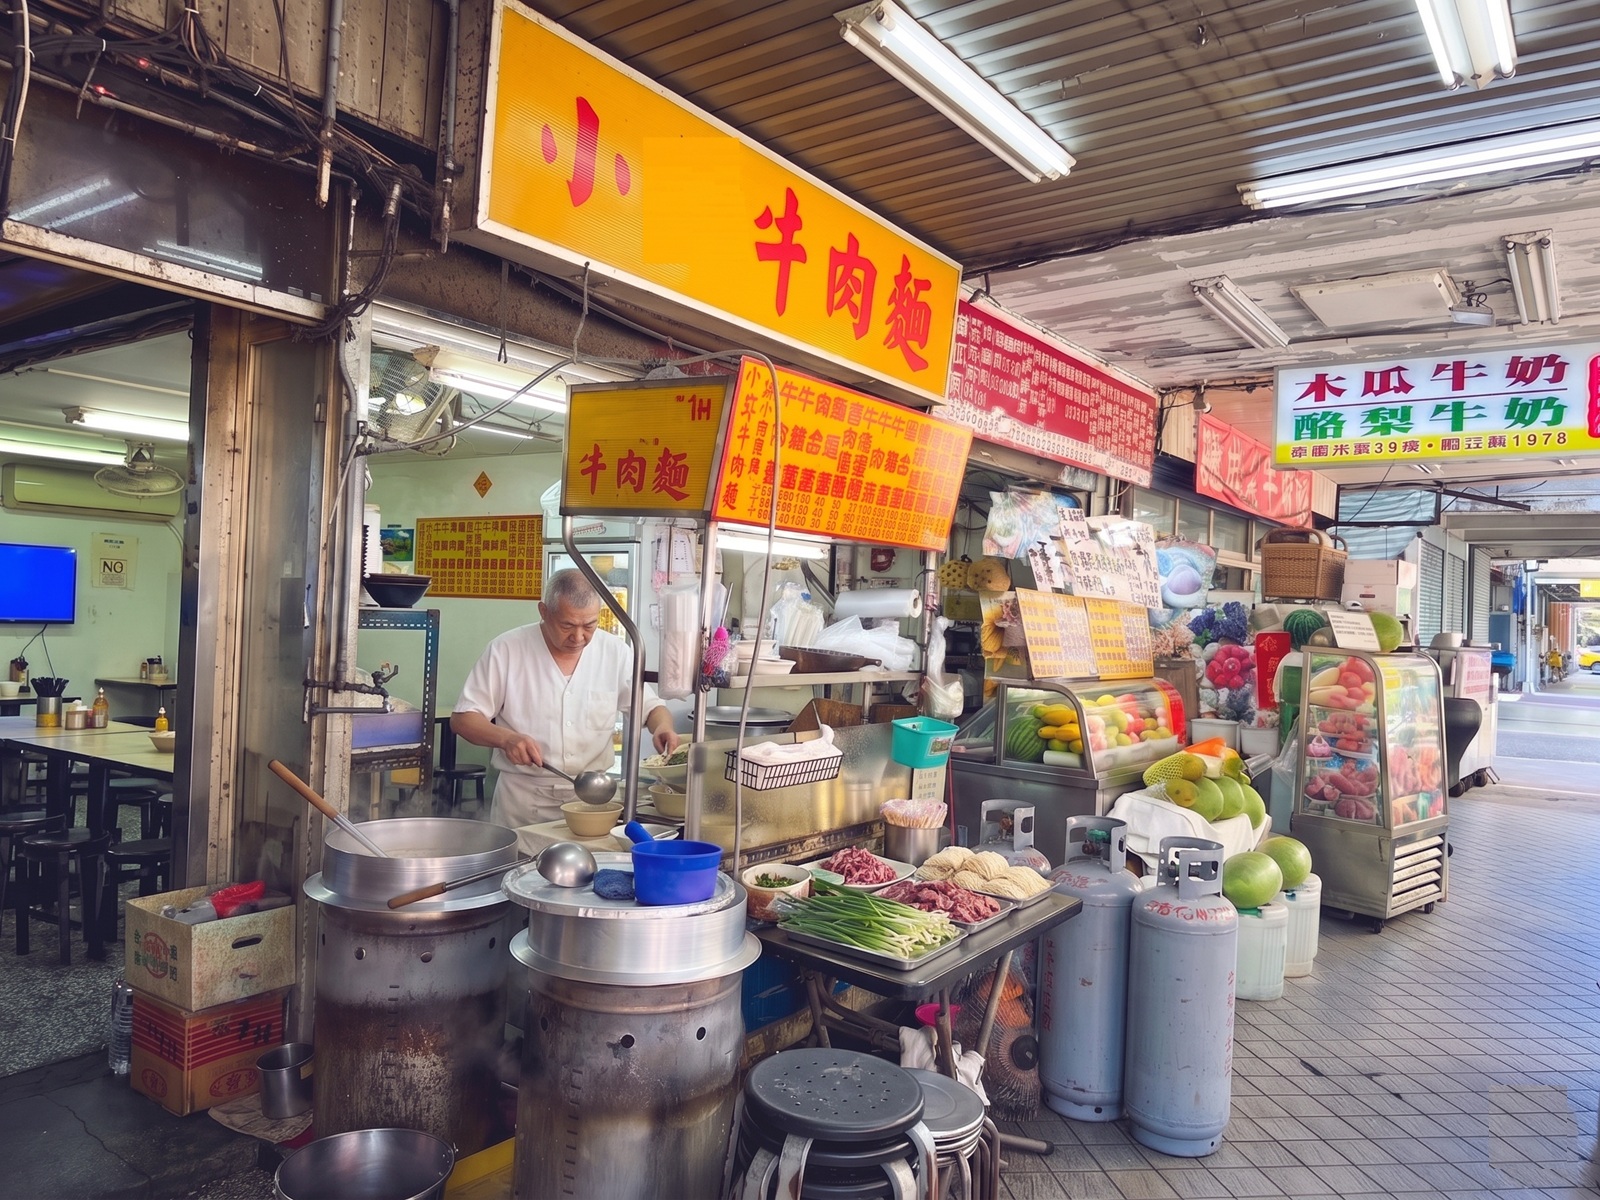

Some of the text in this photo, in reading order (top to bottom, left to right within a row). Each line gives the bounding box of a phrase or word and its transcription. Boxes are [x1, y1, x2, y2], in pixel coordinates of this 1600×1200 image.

[754, 187, 931, 372] 牛肉麵
[1294, 353, 1570, 403] 木瓜牛奶
[1293, 396, 1568, 441] 酪梨牛奶
[579, 443, 690, 501] 牛肉麵
